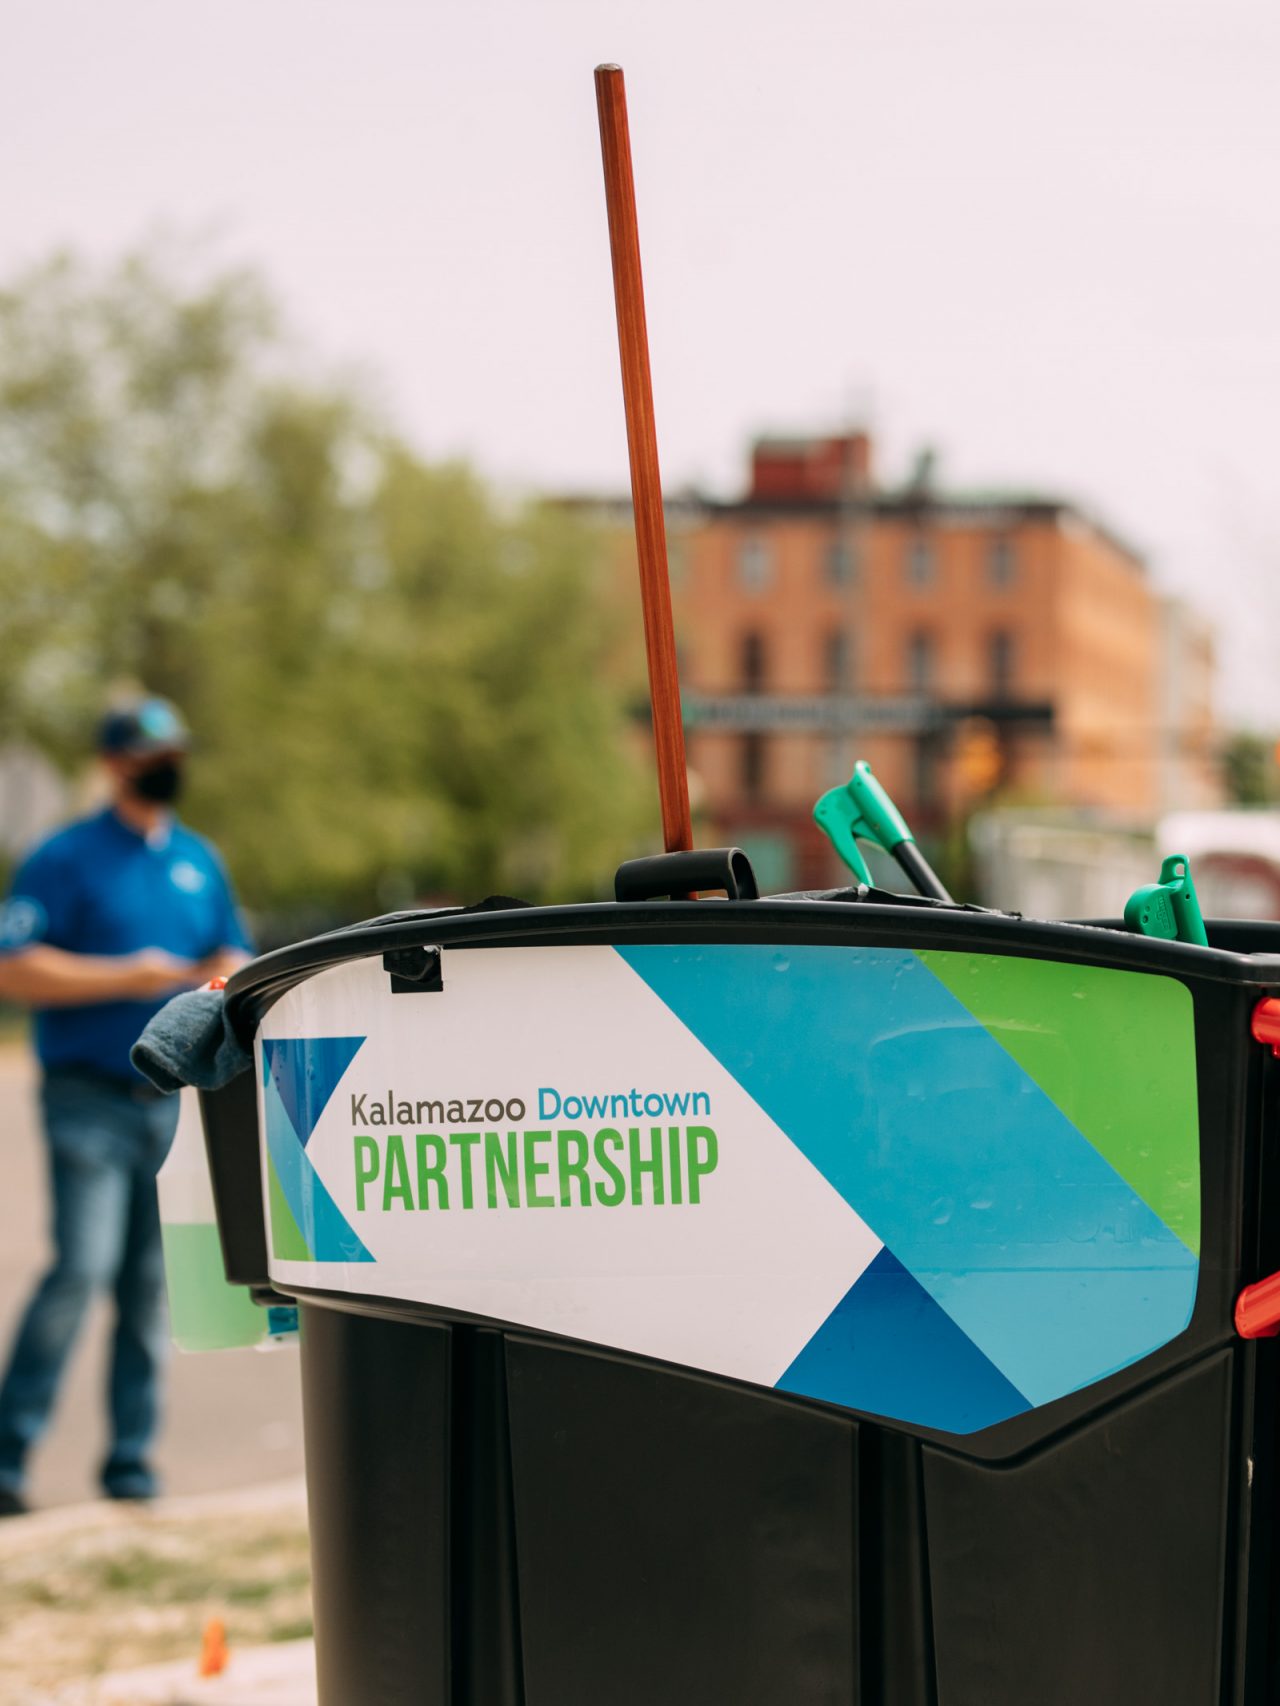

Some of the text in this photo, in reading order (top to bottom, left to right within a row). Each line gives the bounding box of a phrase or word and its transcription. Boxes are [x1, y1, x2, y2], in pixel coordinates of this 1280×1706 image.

[351, 1088, 711, 1126] Kalamazoo Downtown
[353, 1126, 719, 1211] PARTNERSHIP
